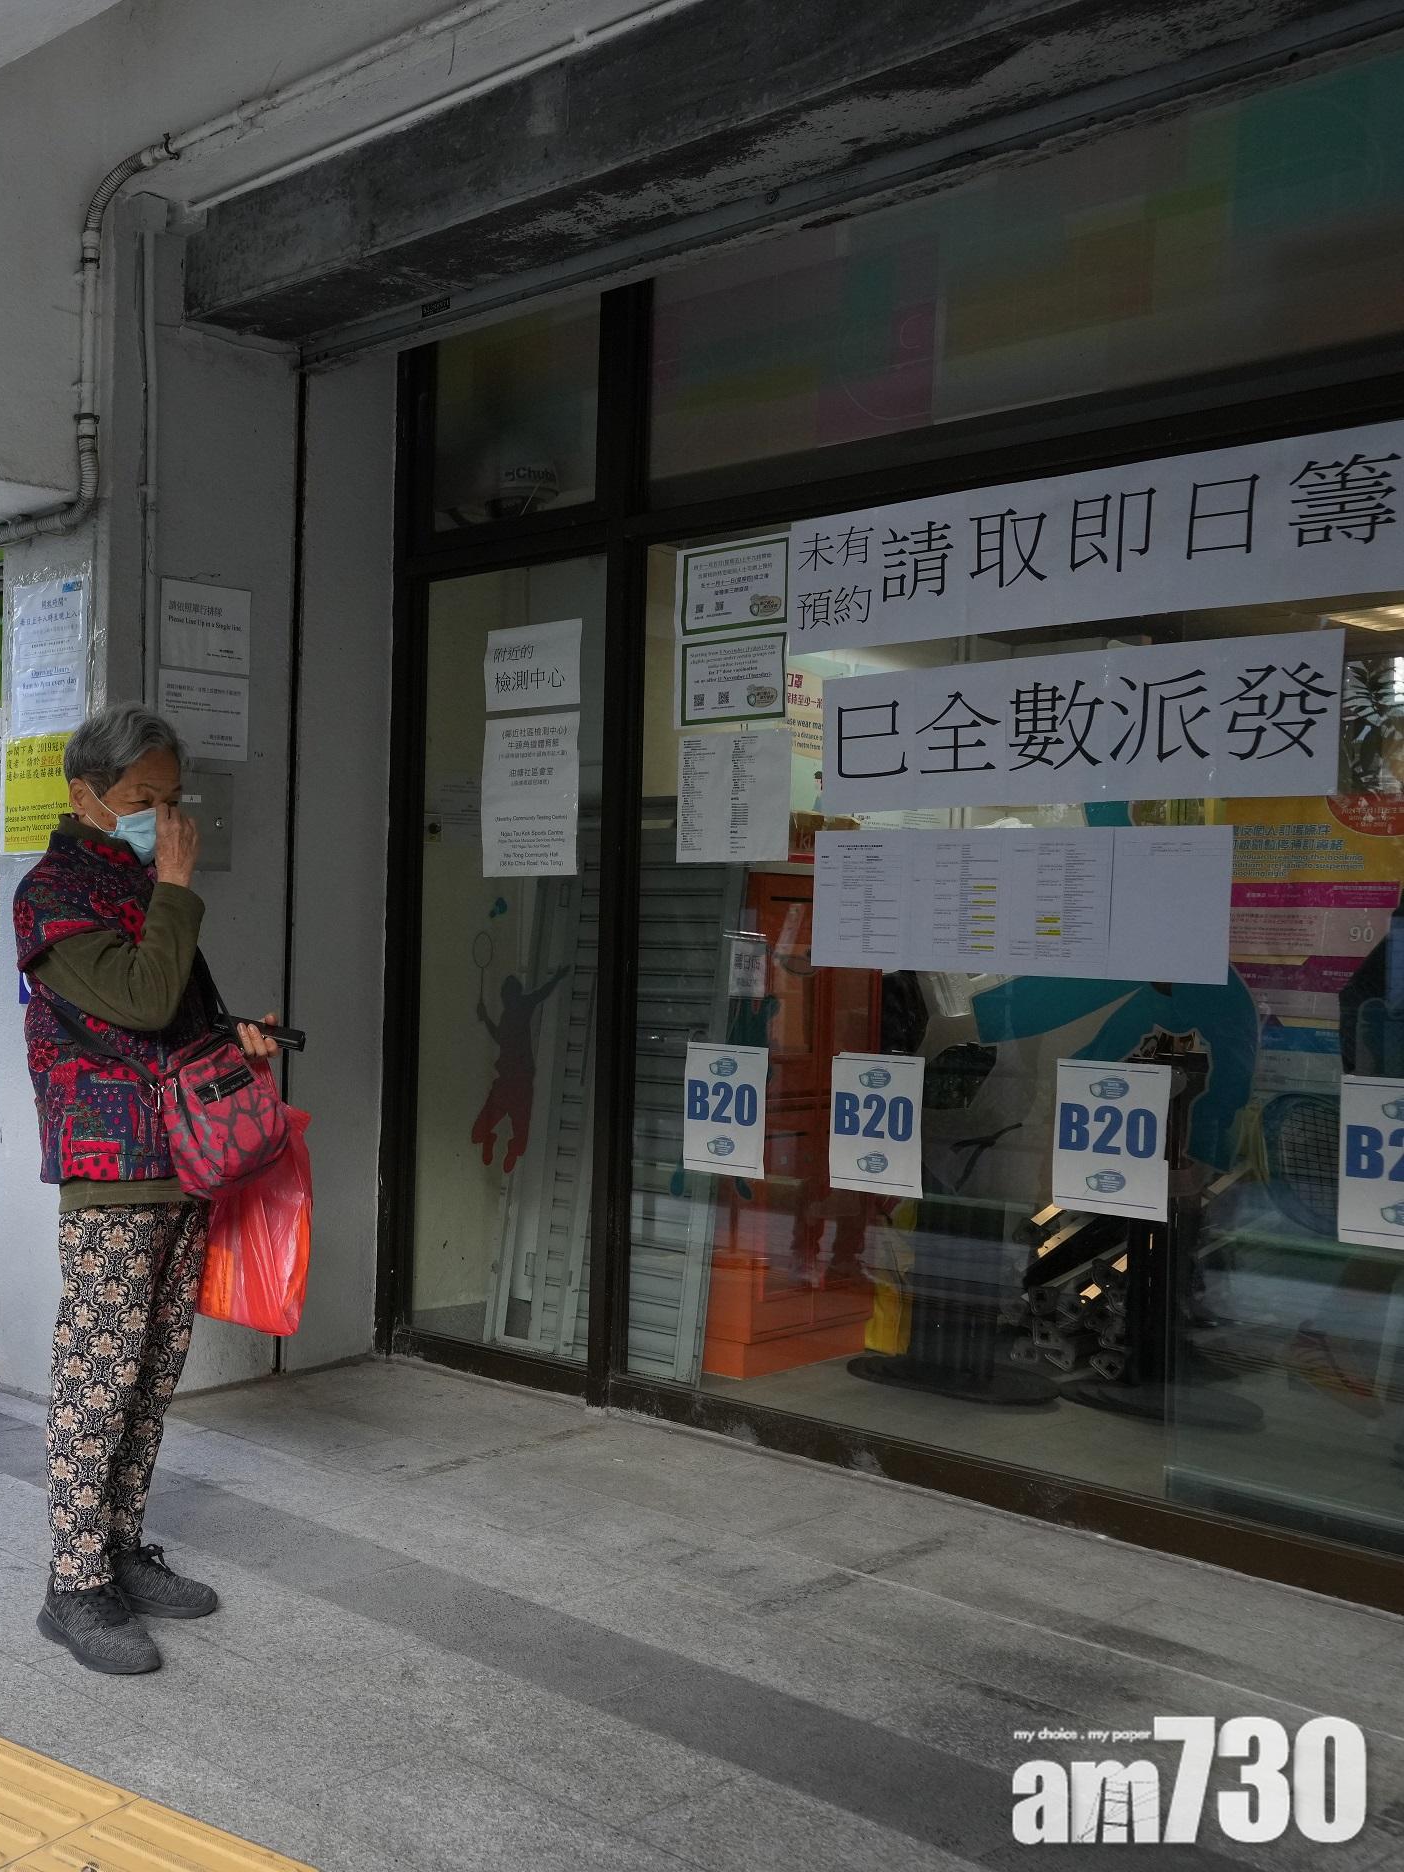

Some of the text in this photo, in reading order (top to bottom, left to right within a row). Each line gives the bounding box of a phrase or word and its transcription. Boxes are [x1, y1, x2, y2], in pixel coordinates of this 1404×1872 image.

[798, 526, 874, 571] 未有
[882, 453, 1402, 604] 請取即日籌
[797, 585, 872, 630] 預約
[493, 644, 534, 663] 附近的
[66, 676, 77, 685] day
[494, 667, 566, 694] 檢測中心
[5, 824, 31, 833] Community
[30, 802, 55, 811] recovered
[687, 1079, 758, 1127] B20
[834, 1091, 914, 1142] B20
[1059, 1103, 1158, 1159] B20
